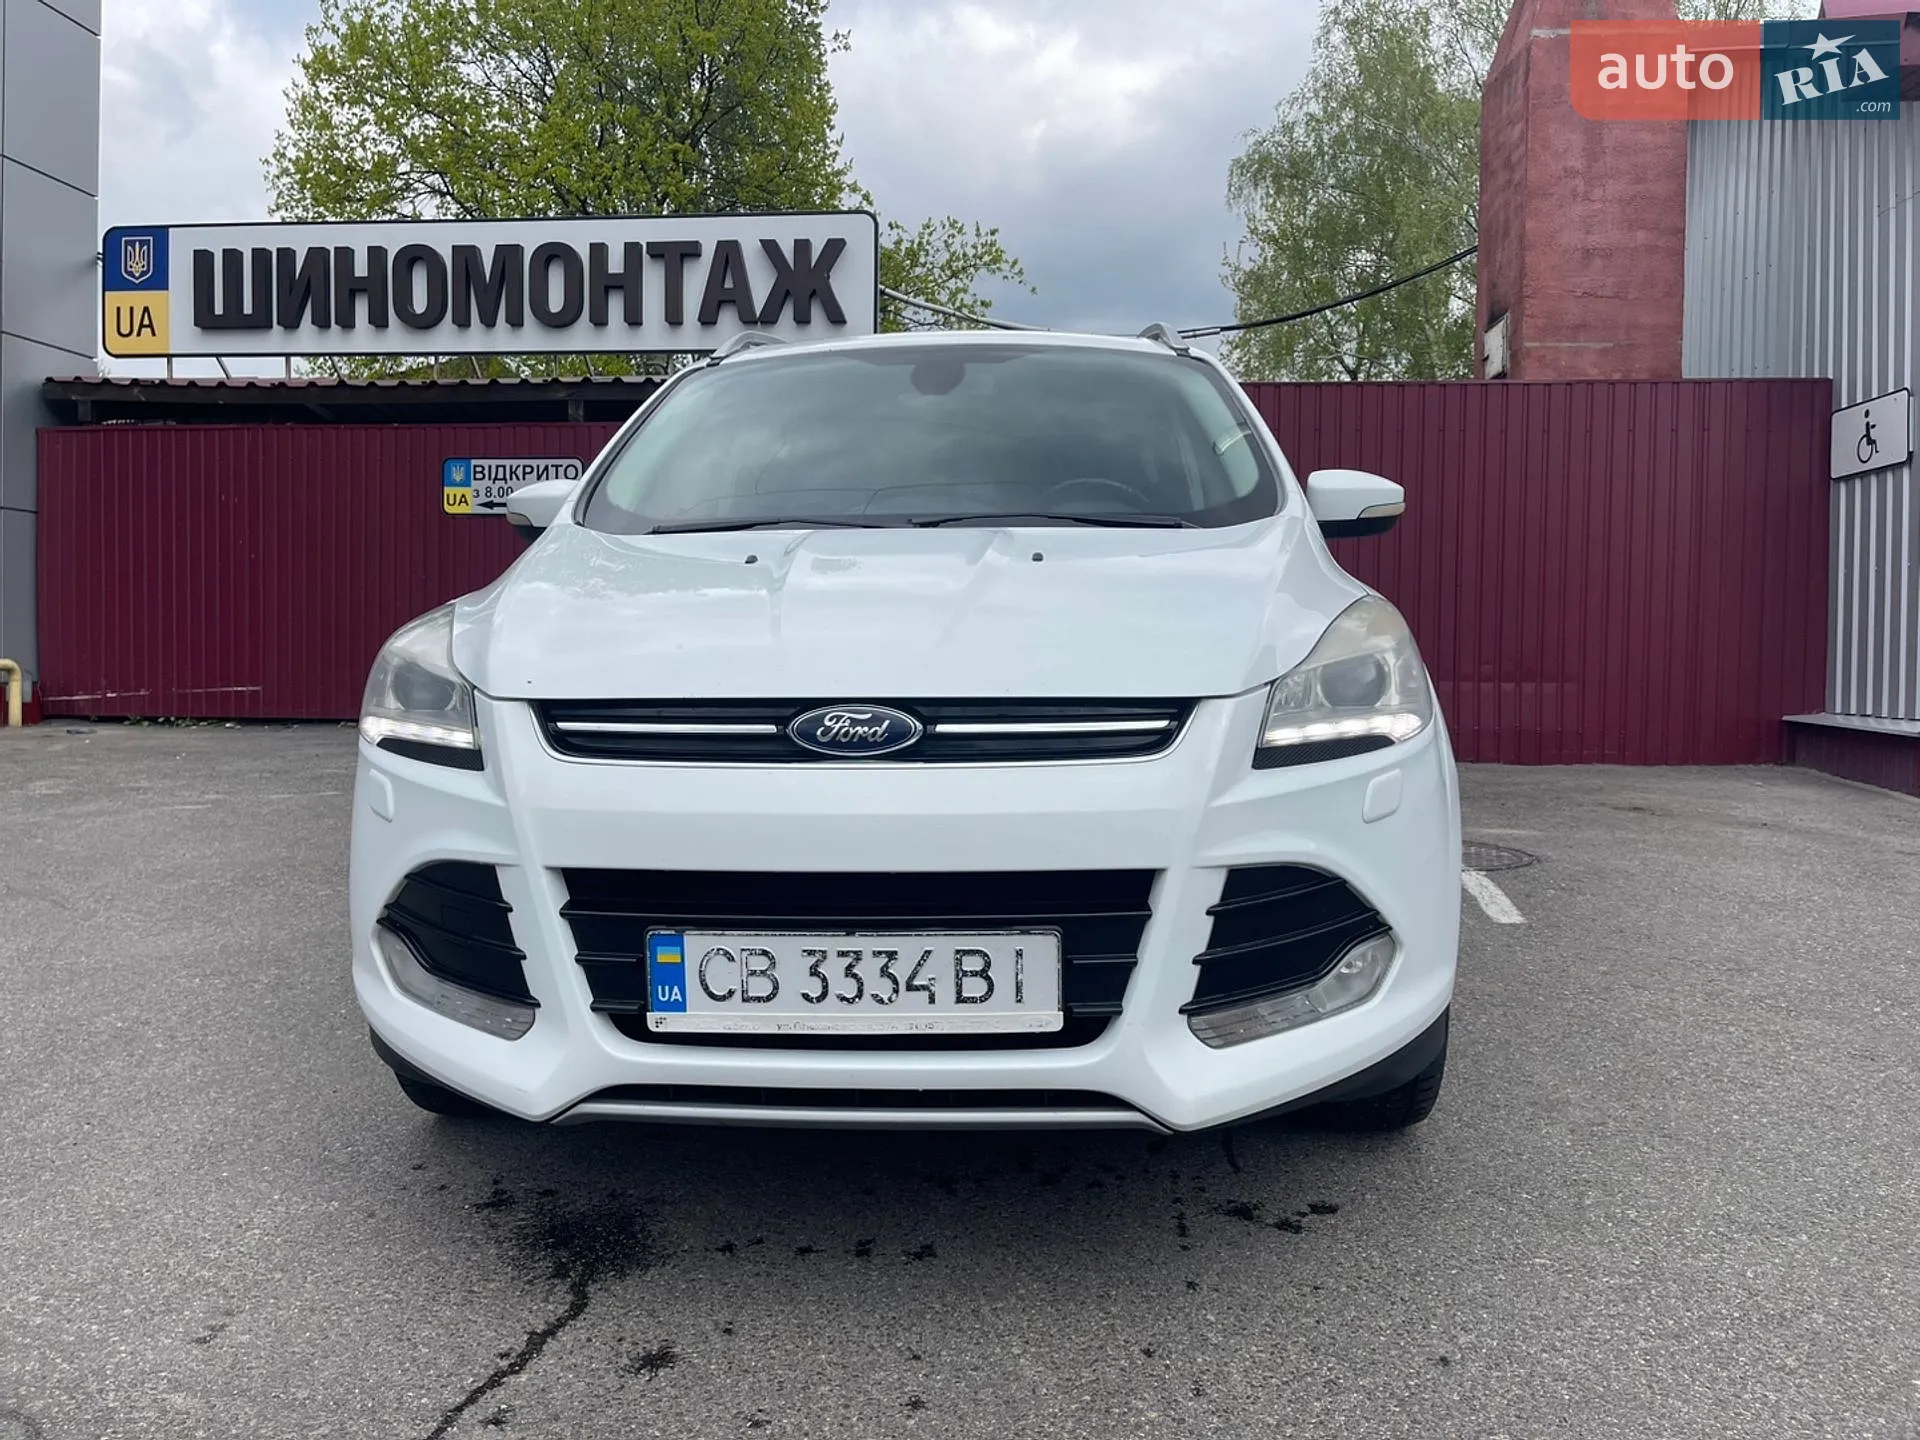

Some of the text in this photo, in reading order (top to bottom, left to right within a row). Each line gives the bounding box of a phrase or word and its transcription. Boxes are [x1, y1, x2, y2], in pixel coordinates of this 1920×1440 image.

[192, 237, 848, 330] ШИНОМОНТАЖ
[115, 305, 157, 339] UA
[472, 464, 579, 484] ВІДКРИТО
[446, 494, 469, 507] UA
[816, 711, 891, 743] Ford
[699, 946, 780, 1004] CB
[800, 947, 937, 1006] 3334
[658, 985, 683, 1002] UA
